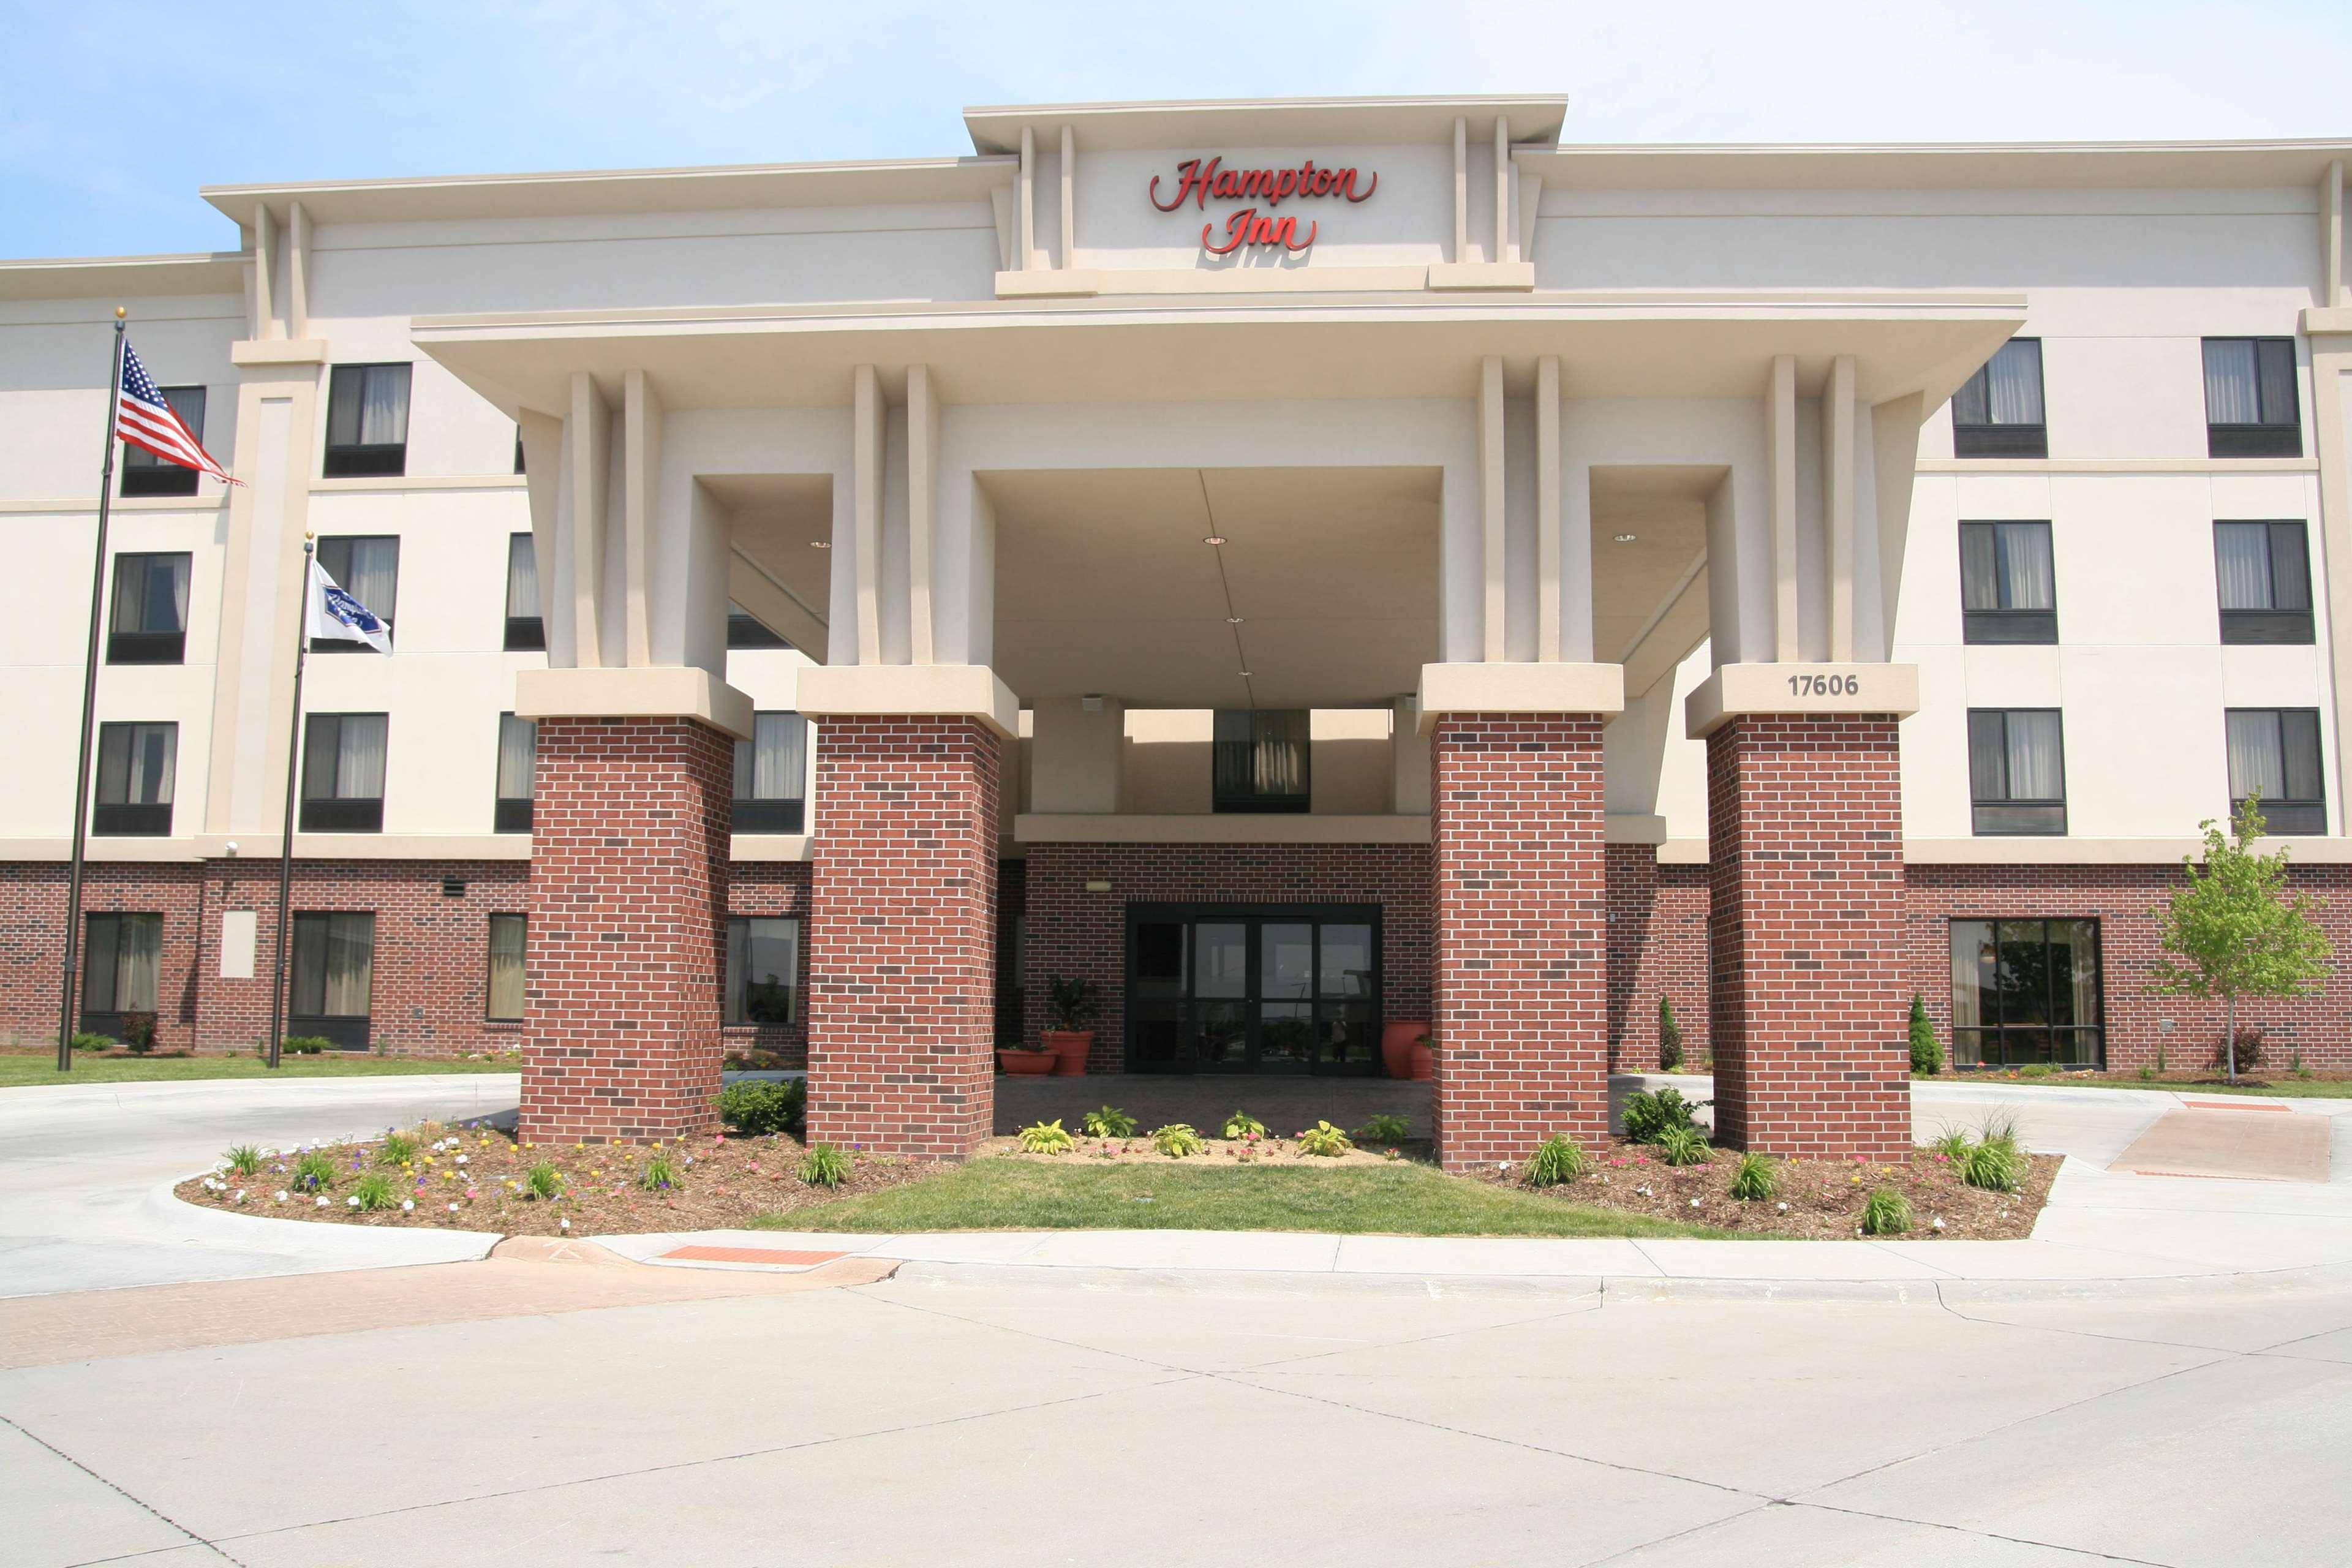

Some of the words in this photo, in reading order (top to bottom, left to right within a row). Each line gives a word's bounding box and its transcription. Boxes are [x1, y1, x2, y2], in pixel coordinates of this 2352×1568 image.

[1150, 156, 1378, 212] Hampton
[1202, 208, 1317, 254] Inn
[1787, 674, 1859, 696] 17606
